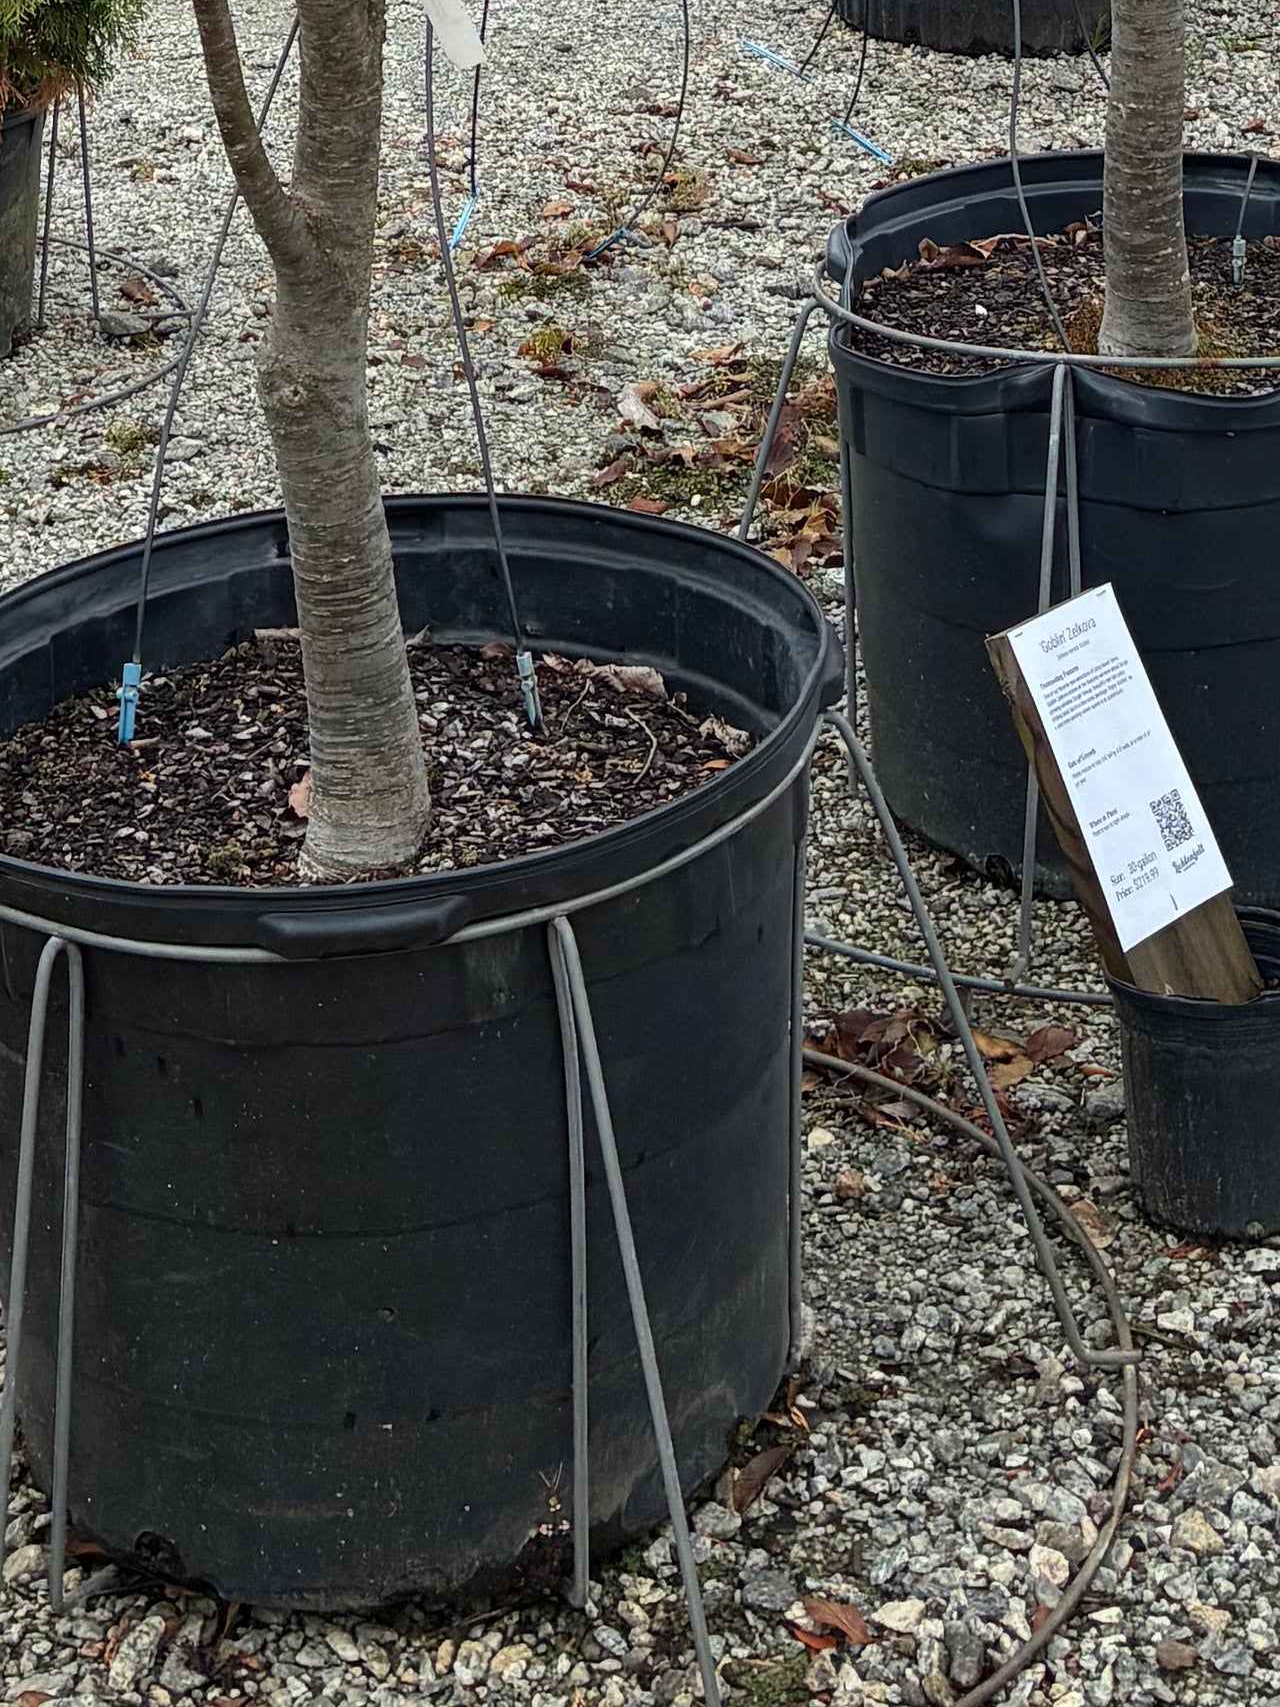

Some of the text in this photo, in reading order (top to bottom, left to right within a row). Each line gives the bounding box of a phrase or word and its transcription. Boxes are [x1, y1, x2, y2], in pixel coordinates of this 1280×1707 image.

[1066, 618, 1097, 640] Zelkova
[1110, 873, 1126, 886] Size:
[1115, 887, 1134, 902] Price:
